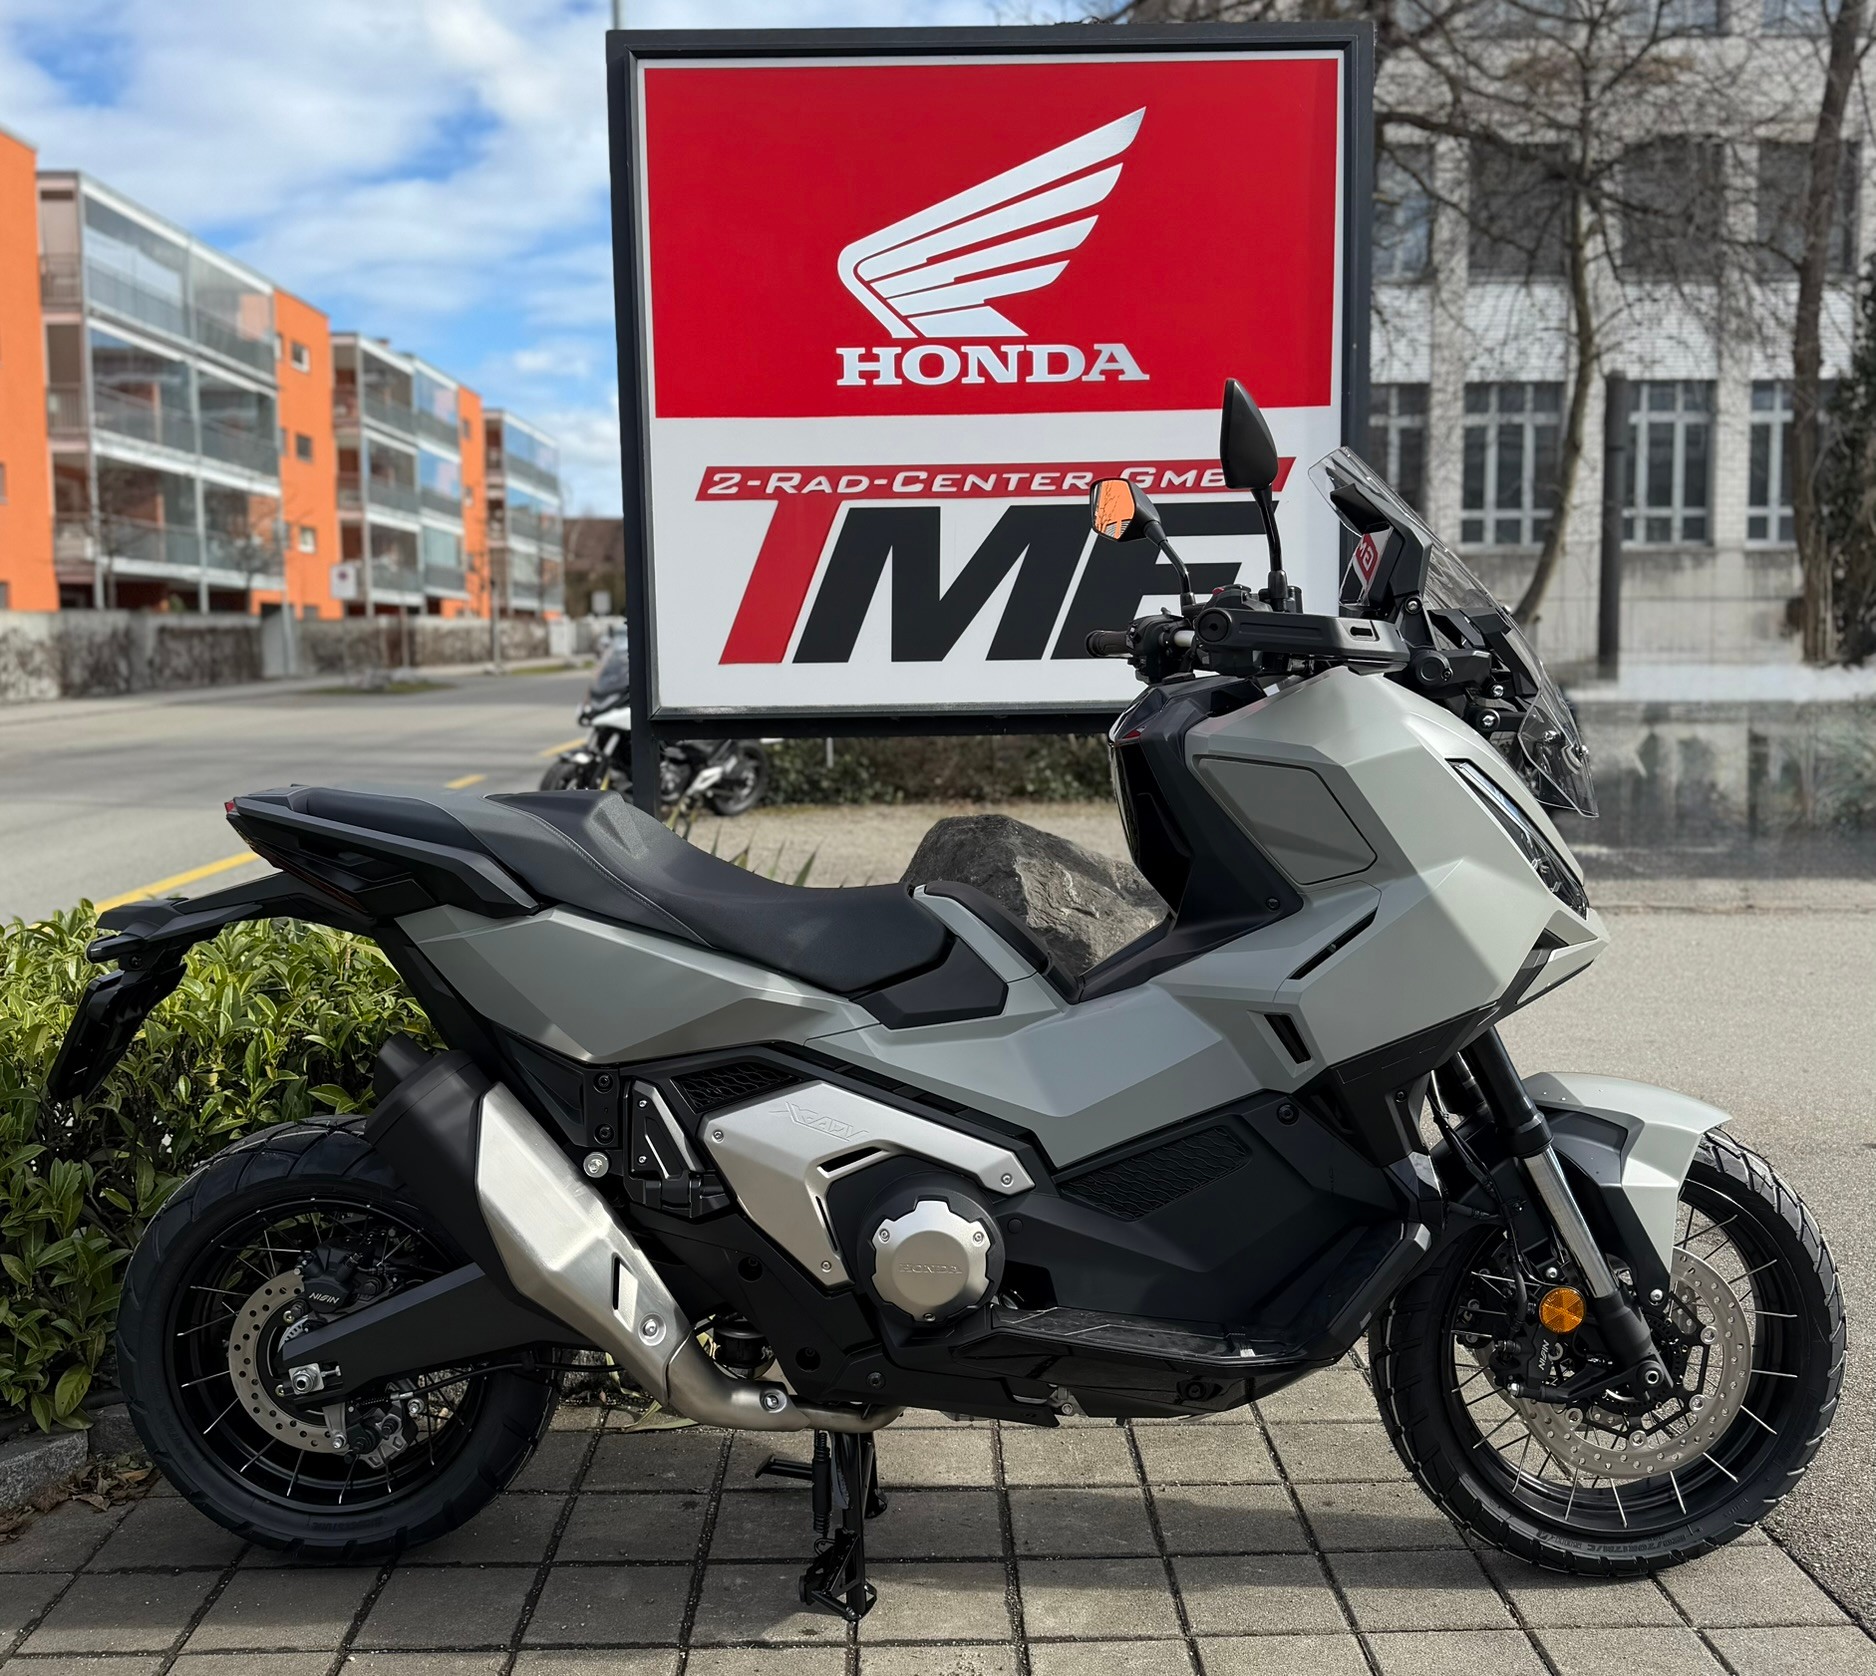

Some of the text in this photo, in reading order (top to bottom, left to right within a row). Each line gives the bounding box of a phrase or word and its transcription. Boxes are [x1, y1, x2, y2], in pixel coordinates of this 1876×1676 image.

[836, 343, 1150, 386] HONDA
[1120, 466, 1226, 489] GMB
[716, 499, 1278, 664] TMF
[898, 1262, 963, 1275] HONDA
